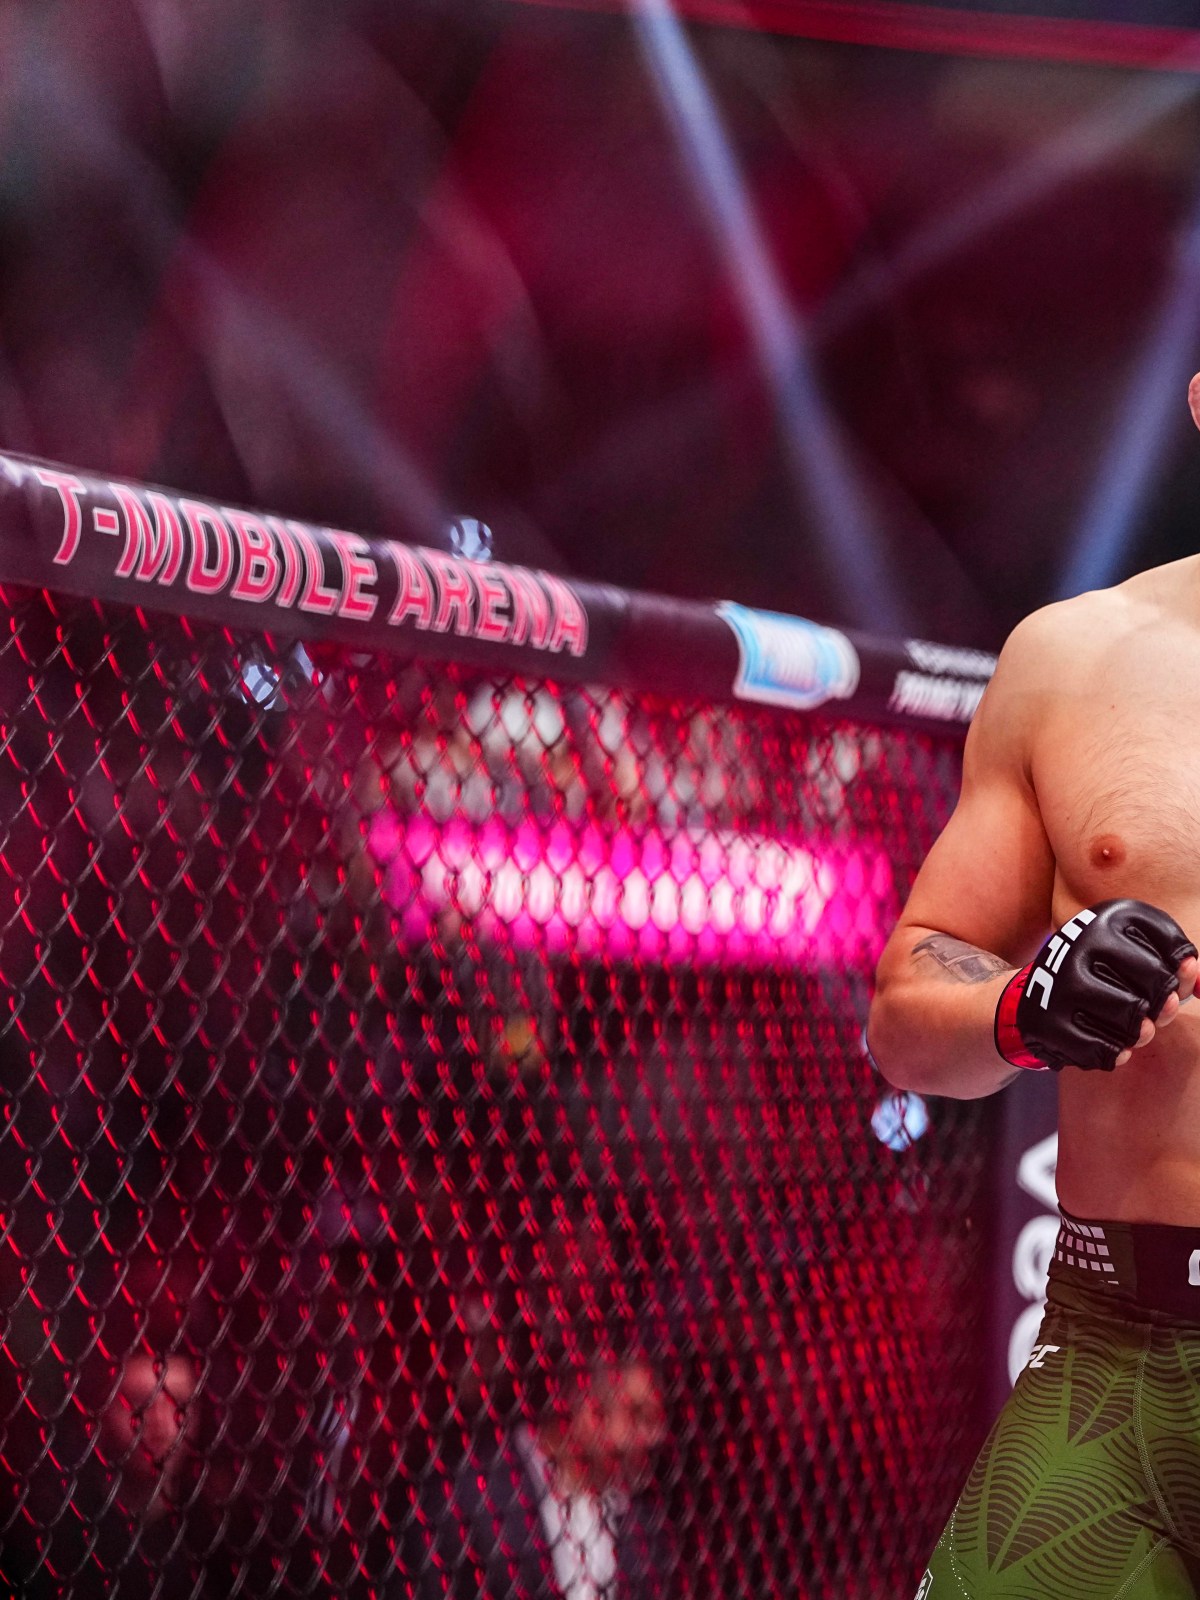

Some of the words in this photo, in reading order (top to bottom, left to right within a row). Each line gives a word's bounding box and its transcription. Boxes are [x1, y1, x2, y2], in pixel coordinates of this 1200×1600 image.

[33, 466, 379, 621] T-MOBILE
[386, 539, 589, 658] ARENA
[1026, 907, 1098, 1011] UFC
